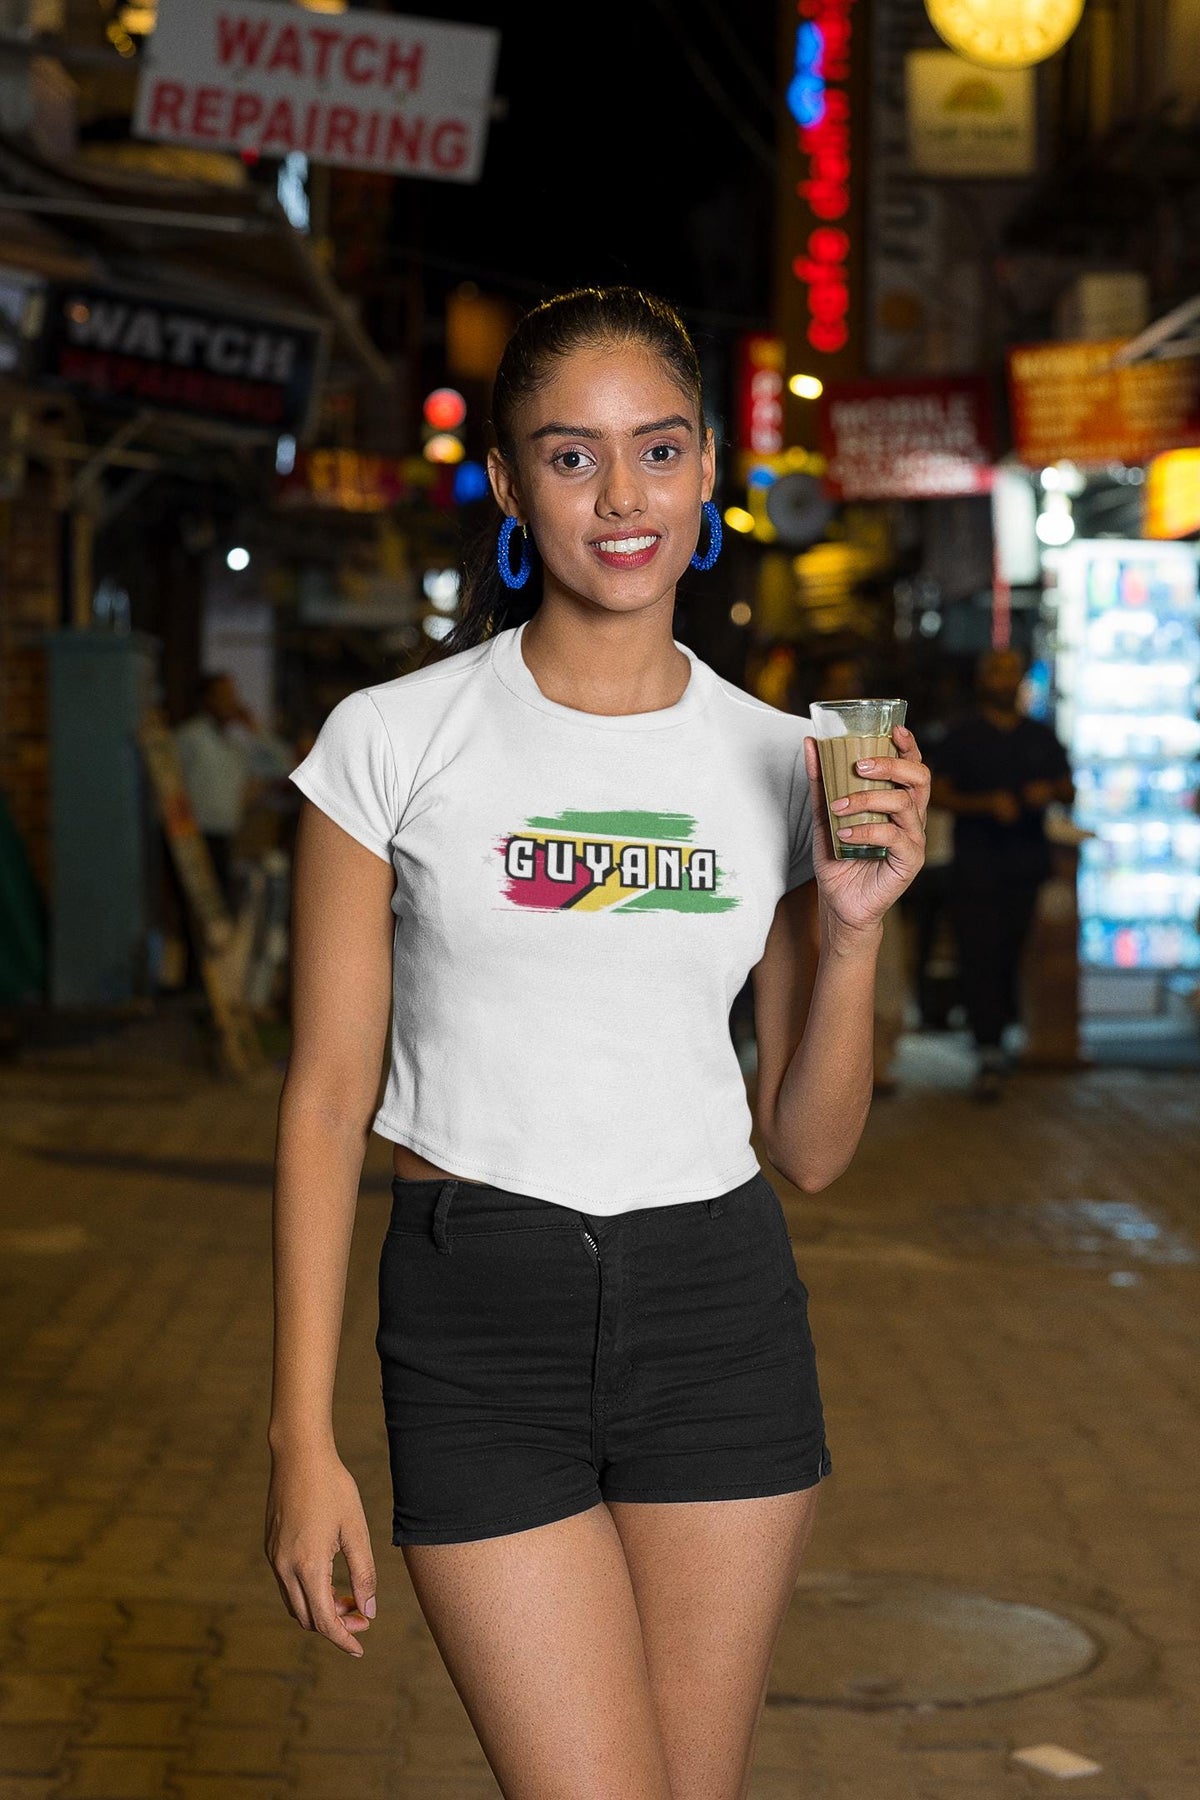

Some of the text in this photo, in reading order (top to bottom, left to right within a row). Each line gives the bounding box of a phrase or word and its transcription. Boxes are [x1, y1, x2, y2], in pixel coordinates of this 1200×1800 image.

[215, 12, 425, 92] WATCH
[148, 78, 470, 172] REPAIRING
[65, 301, 295, 383] WATCH
[505, 836, 716, 891] GUYANA
